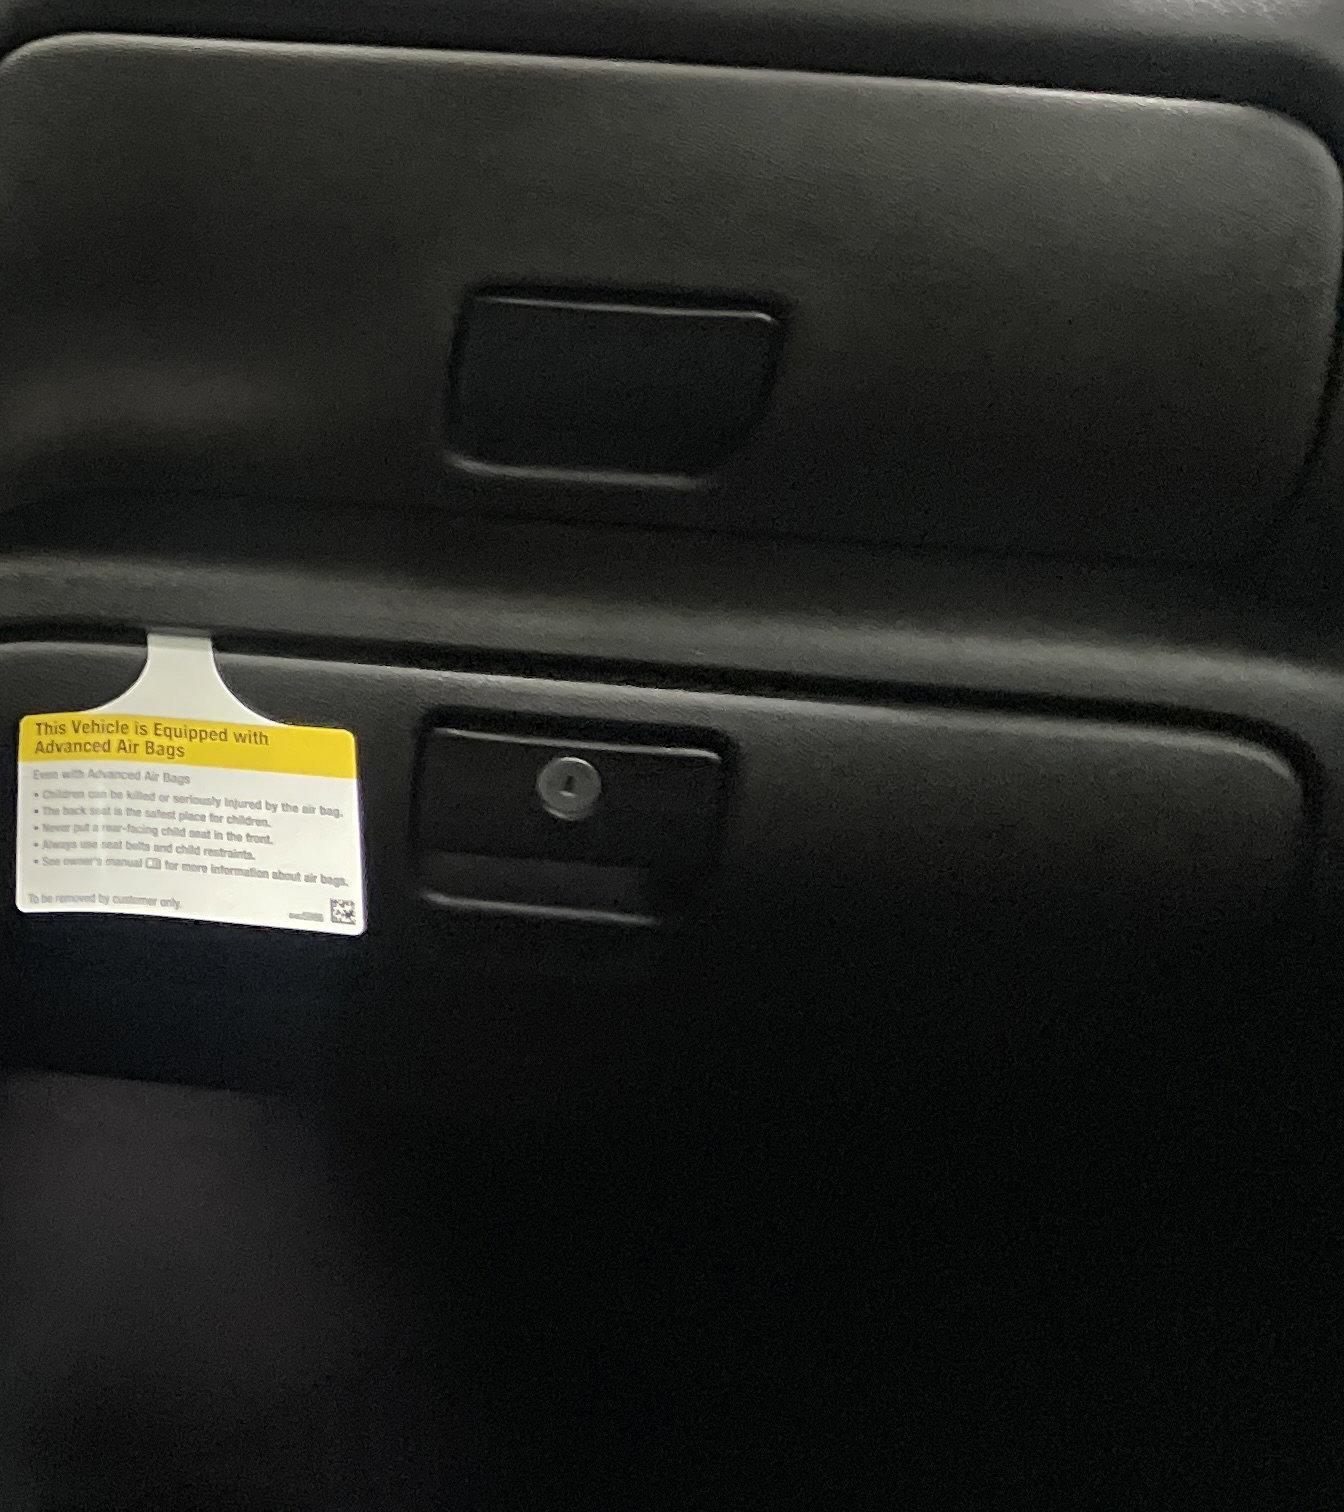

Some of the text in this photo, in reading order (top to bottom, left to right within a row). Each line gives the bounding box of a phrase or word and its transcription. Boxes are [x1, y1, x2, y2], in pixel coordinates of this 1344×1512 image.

[36, 720, 270, 745] This Vehicle is Equipped with
[34, 739, 185, 759] Advanced Air Bags
[33, 769, 190, 786] Even with Advanced Air Bags
[110, 790, 123, 800] be
[126, 791, 156, 801] killed
[159, 794, 170, 802] or
[173, 794, 221, 808] seriously
[224, 797, 262, 810] injured
[265, 800, 278, 813] by
[281, 802, 298, 813] the
[302, 804, 316, 814] air
[319, 805, 343, 819] bag.
[42, 807, 60, 816] The
[63, 806, 86, 816] back
[114, 807, 123, 816] is
[126, 807, 142, 817] the
[145, 808, 176, 820] safest
[178, 811, 206, 822] place
[209, 813, 224, 824] for
[226, 814, 271, 827] children.
[42, 823, 70, 832] Never
[73, 823, 90, 833] put
[102, 823, 158, 837] rear-facing
[160, 826, 186, 837] child
[189, 829, 211, 839] seat
[214, 830, 223, 840] in
[226, 831, 242, 842] the
[245, 833, 273, 845] front.
[42, 840, 77, 851] Always
[80, 841, 97, 849] use
[101, 841, 122, 849] seat
[125, 841, 150, 851] belts
[154, 843, 173, 853] and
[175, 844, 201, 855] child
[42, 857, 60, 866] See
[106, 857, 143, 867] manual
[164, 860, 178, 870] for
[181, 863, 208, 873] more
[210, 864, 269, 879] information
[271, 870, 301, 882] about
[304, 873, 317, 883] air
[320, 874, 349, 888] bags.
[28, 893, 39, 904] To
[41, 894, 53, 903] be
[55, 893, 95, 903] removed
[98, 894, 110, 905] by
